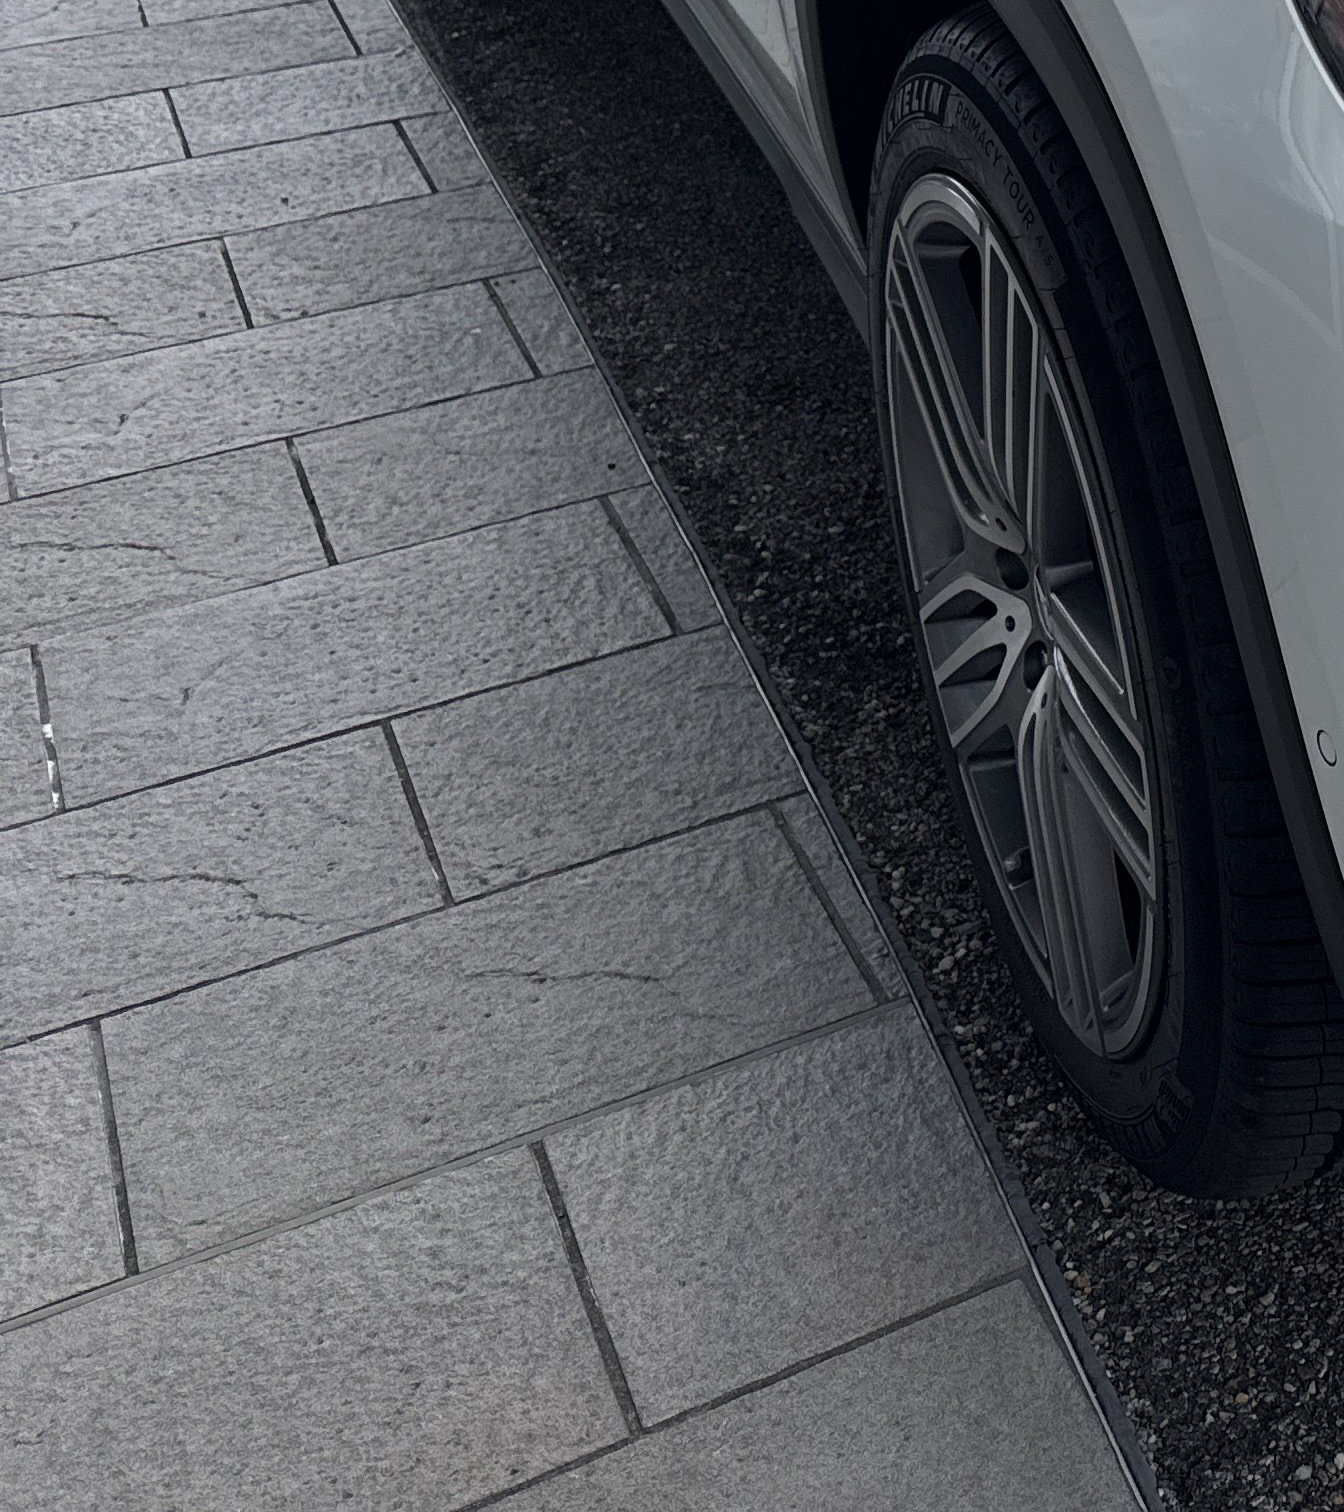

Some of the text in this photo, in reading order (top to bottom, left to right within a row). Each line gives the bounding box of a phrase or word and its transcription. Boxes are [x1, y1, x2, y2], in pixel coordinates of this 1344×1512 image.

[881, 79, 944, 148] ICHELIN
[956, 101, 1002, 166] PRIMACY
[1003, 167, 1034, 229] TOUR
